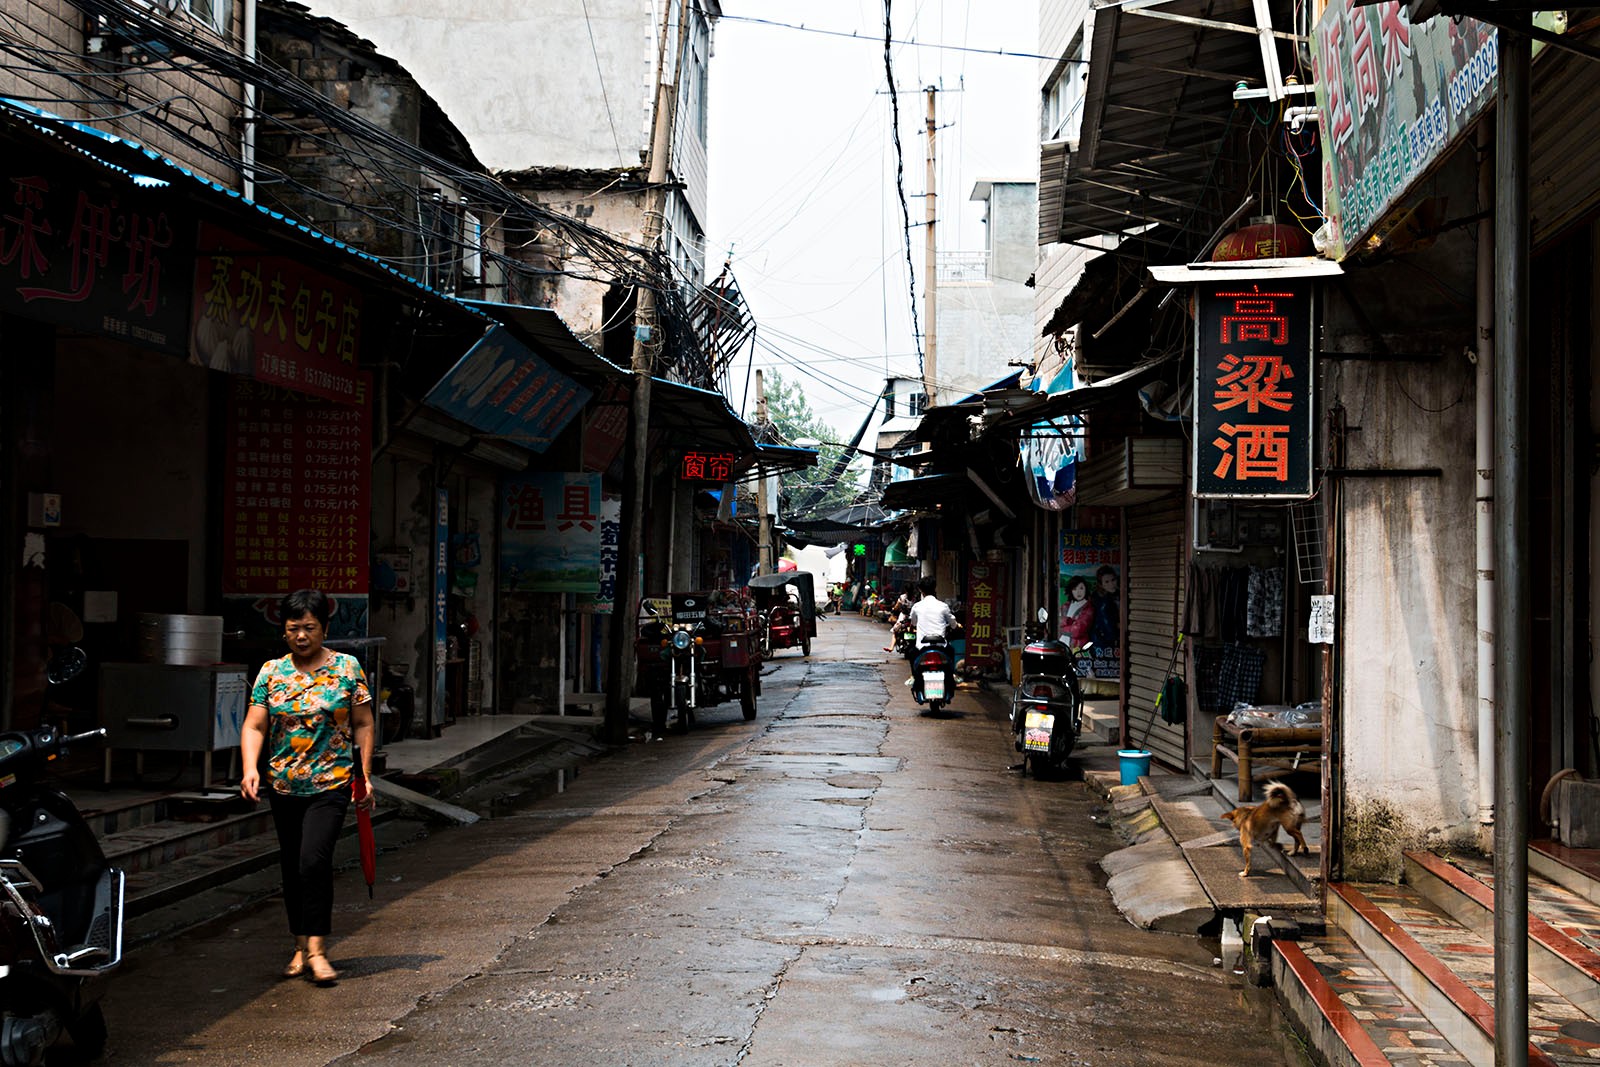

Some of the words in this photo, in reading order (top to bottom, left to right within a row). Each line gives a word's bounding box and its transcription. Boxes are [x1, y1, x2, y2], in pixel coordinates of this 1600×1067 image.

[203, 248, 360, 365] 蒸功夫包子店
[1212, 284, 1295, 482] 高粱酒
[304, 469, 360, 481] 0.75元/1个
[683, 453, 734, 481] 窗帘
[304, 484, 360, 495] 0.75元/1个
[304, 498, 360, 510] 0.75元/1个
[507, 484, 597, 532] 渔具
[971, 583, 993, 659] 金银加工
